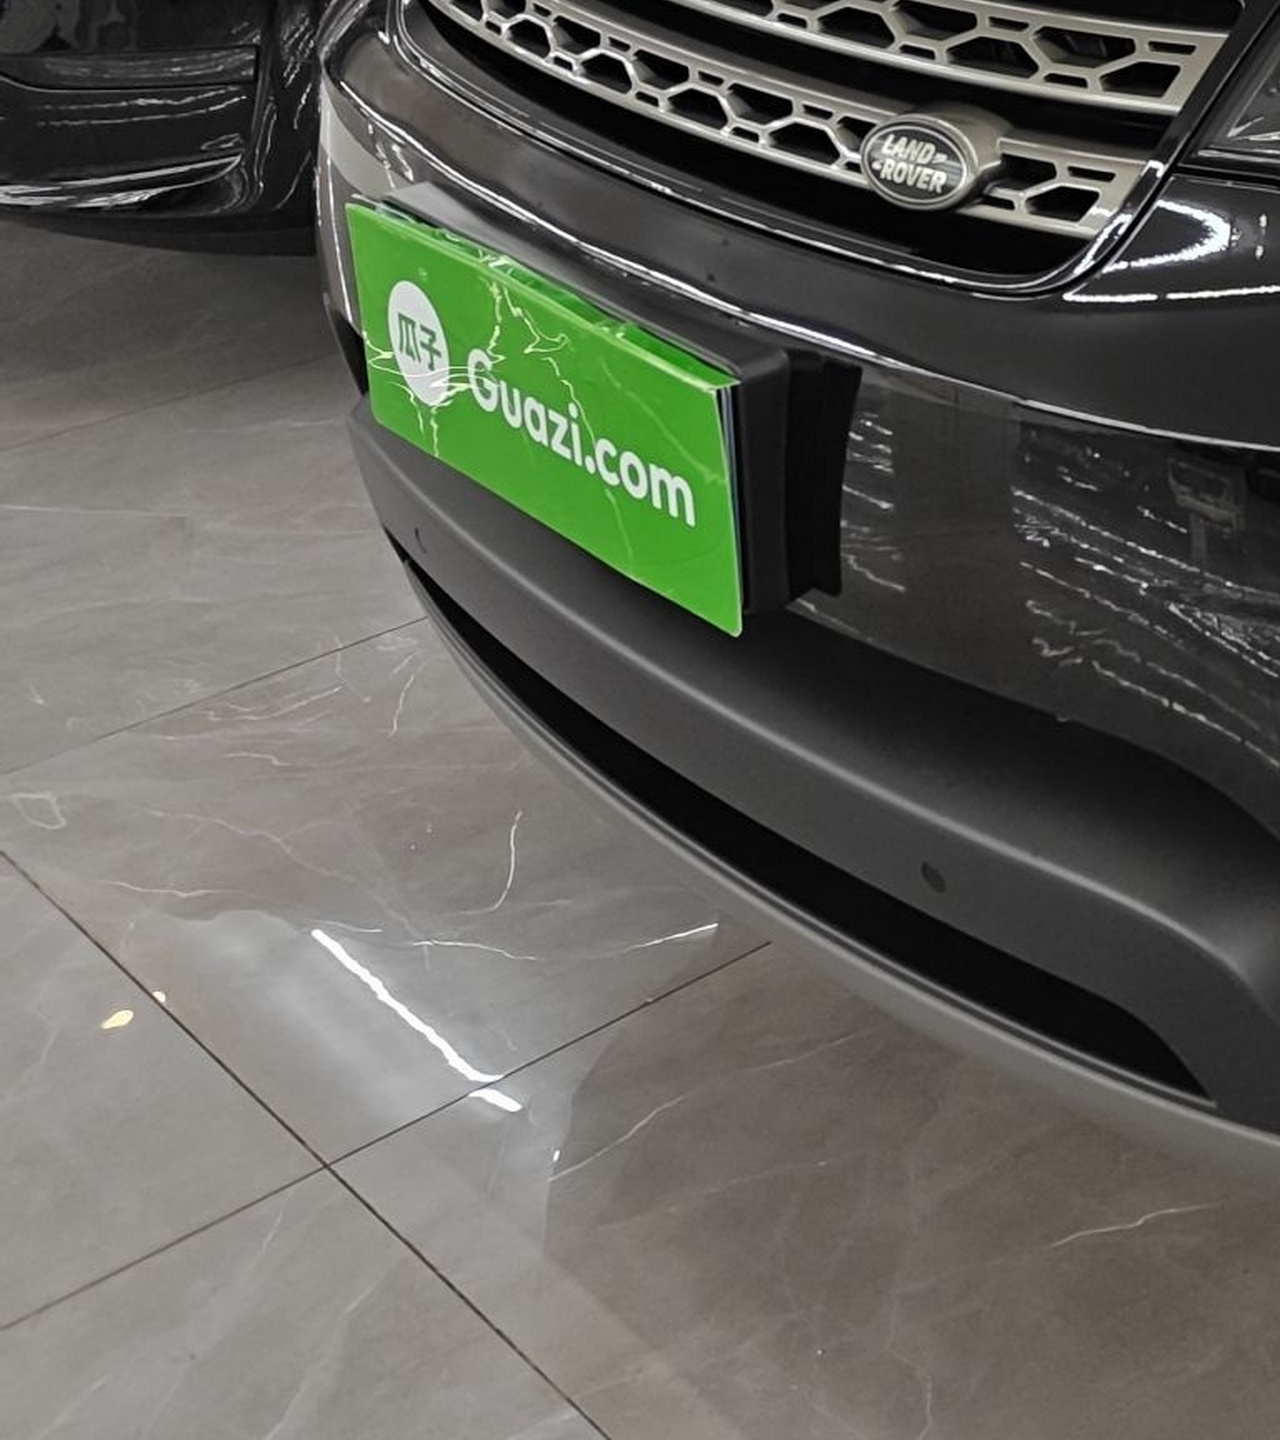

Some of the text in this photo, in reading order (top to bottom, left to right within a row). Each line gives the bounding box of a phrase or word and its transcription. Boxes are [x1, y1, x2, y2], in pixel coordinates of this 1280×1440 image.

[882, 133, 936, 164] LAND
[880, 158, 947, 194] ROVER
[397, 312, 442, 372] 瓜子
[467, 347, 696, 527] Guazi.com
